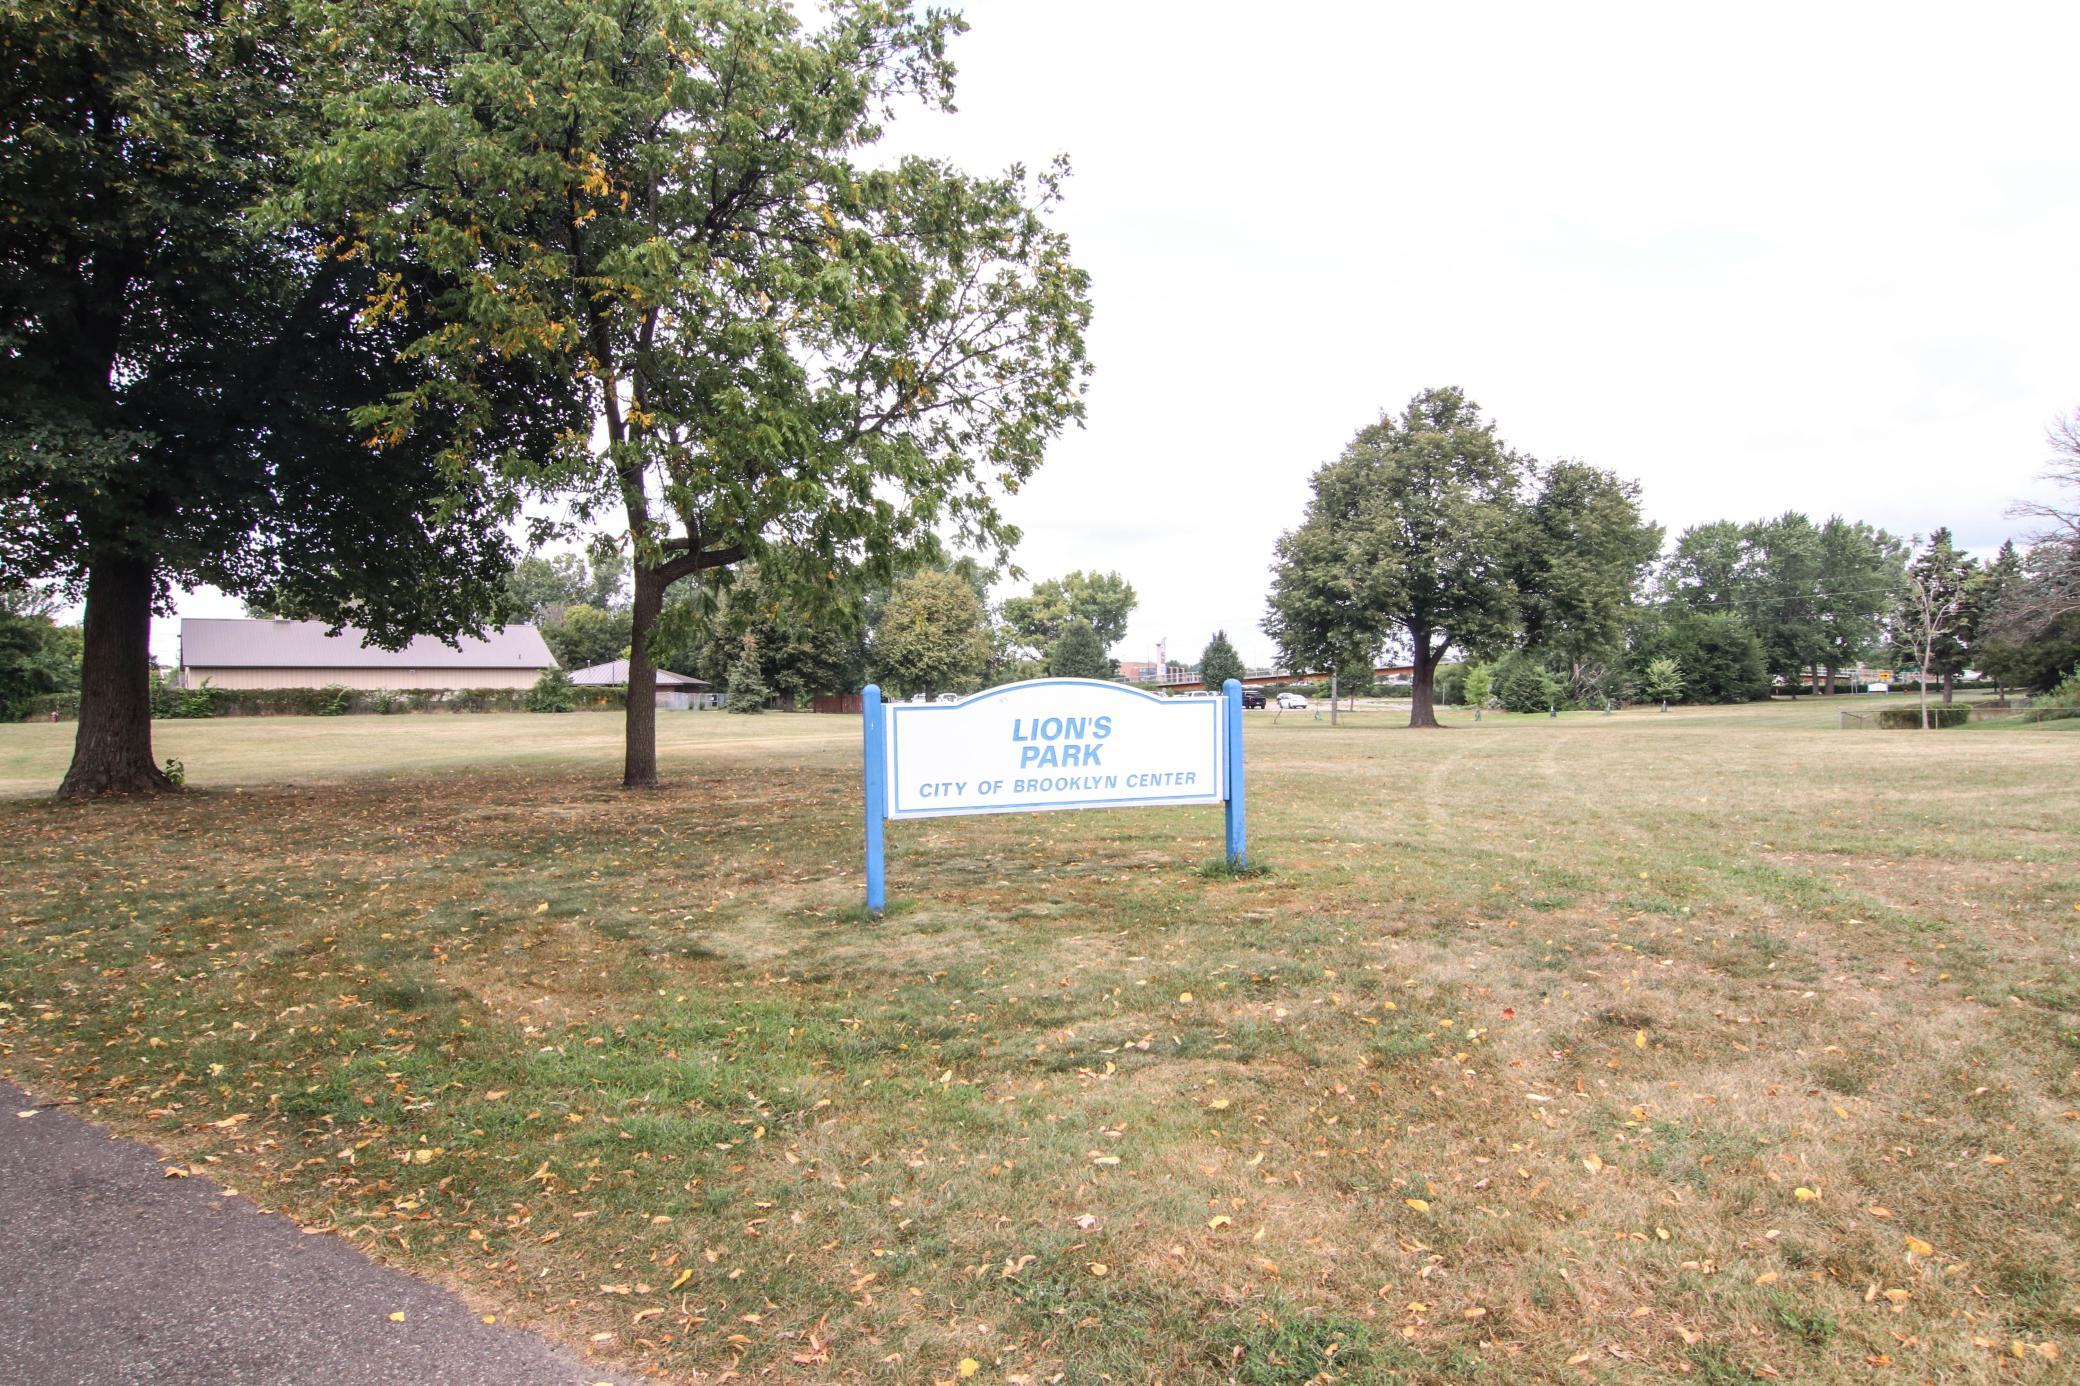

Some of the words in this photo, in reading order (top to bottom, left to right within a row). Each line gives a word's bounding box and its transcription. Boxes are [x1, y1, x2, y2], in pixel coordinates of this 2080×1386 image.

[1012, 715, 1112, 742] LION'S
[1019, 743, 1104, 769] PARK
[919, 782, 967, 798] CITY
[977, 780, 1003, 795] OF
[1013, 775, 1118, 793] BROOKLYN
[1126, 772, 1197, 788] CENTER
